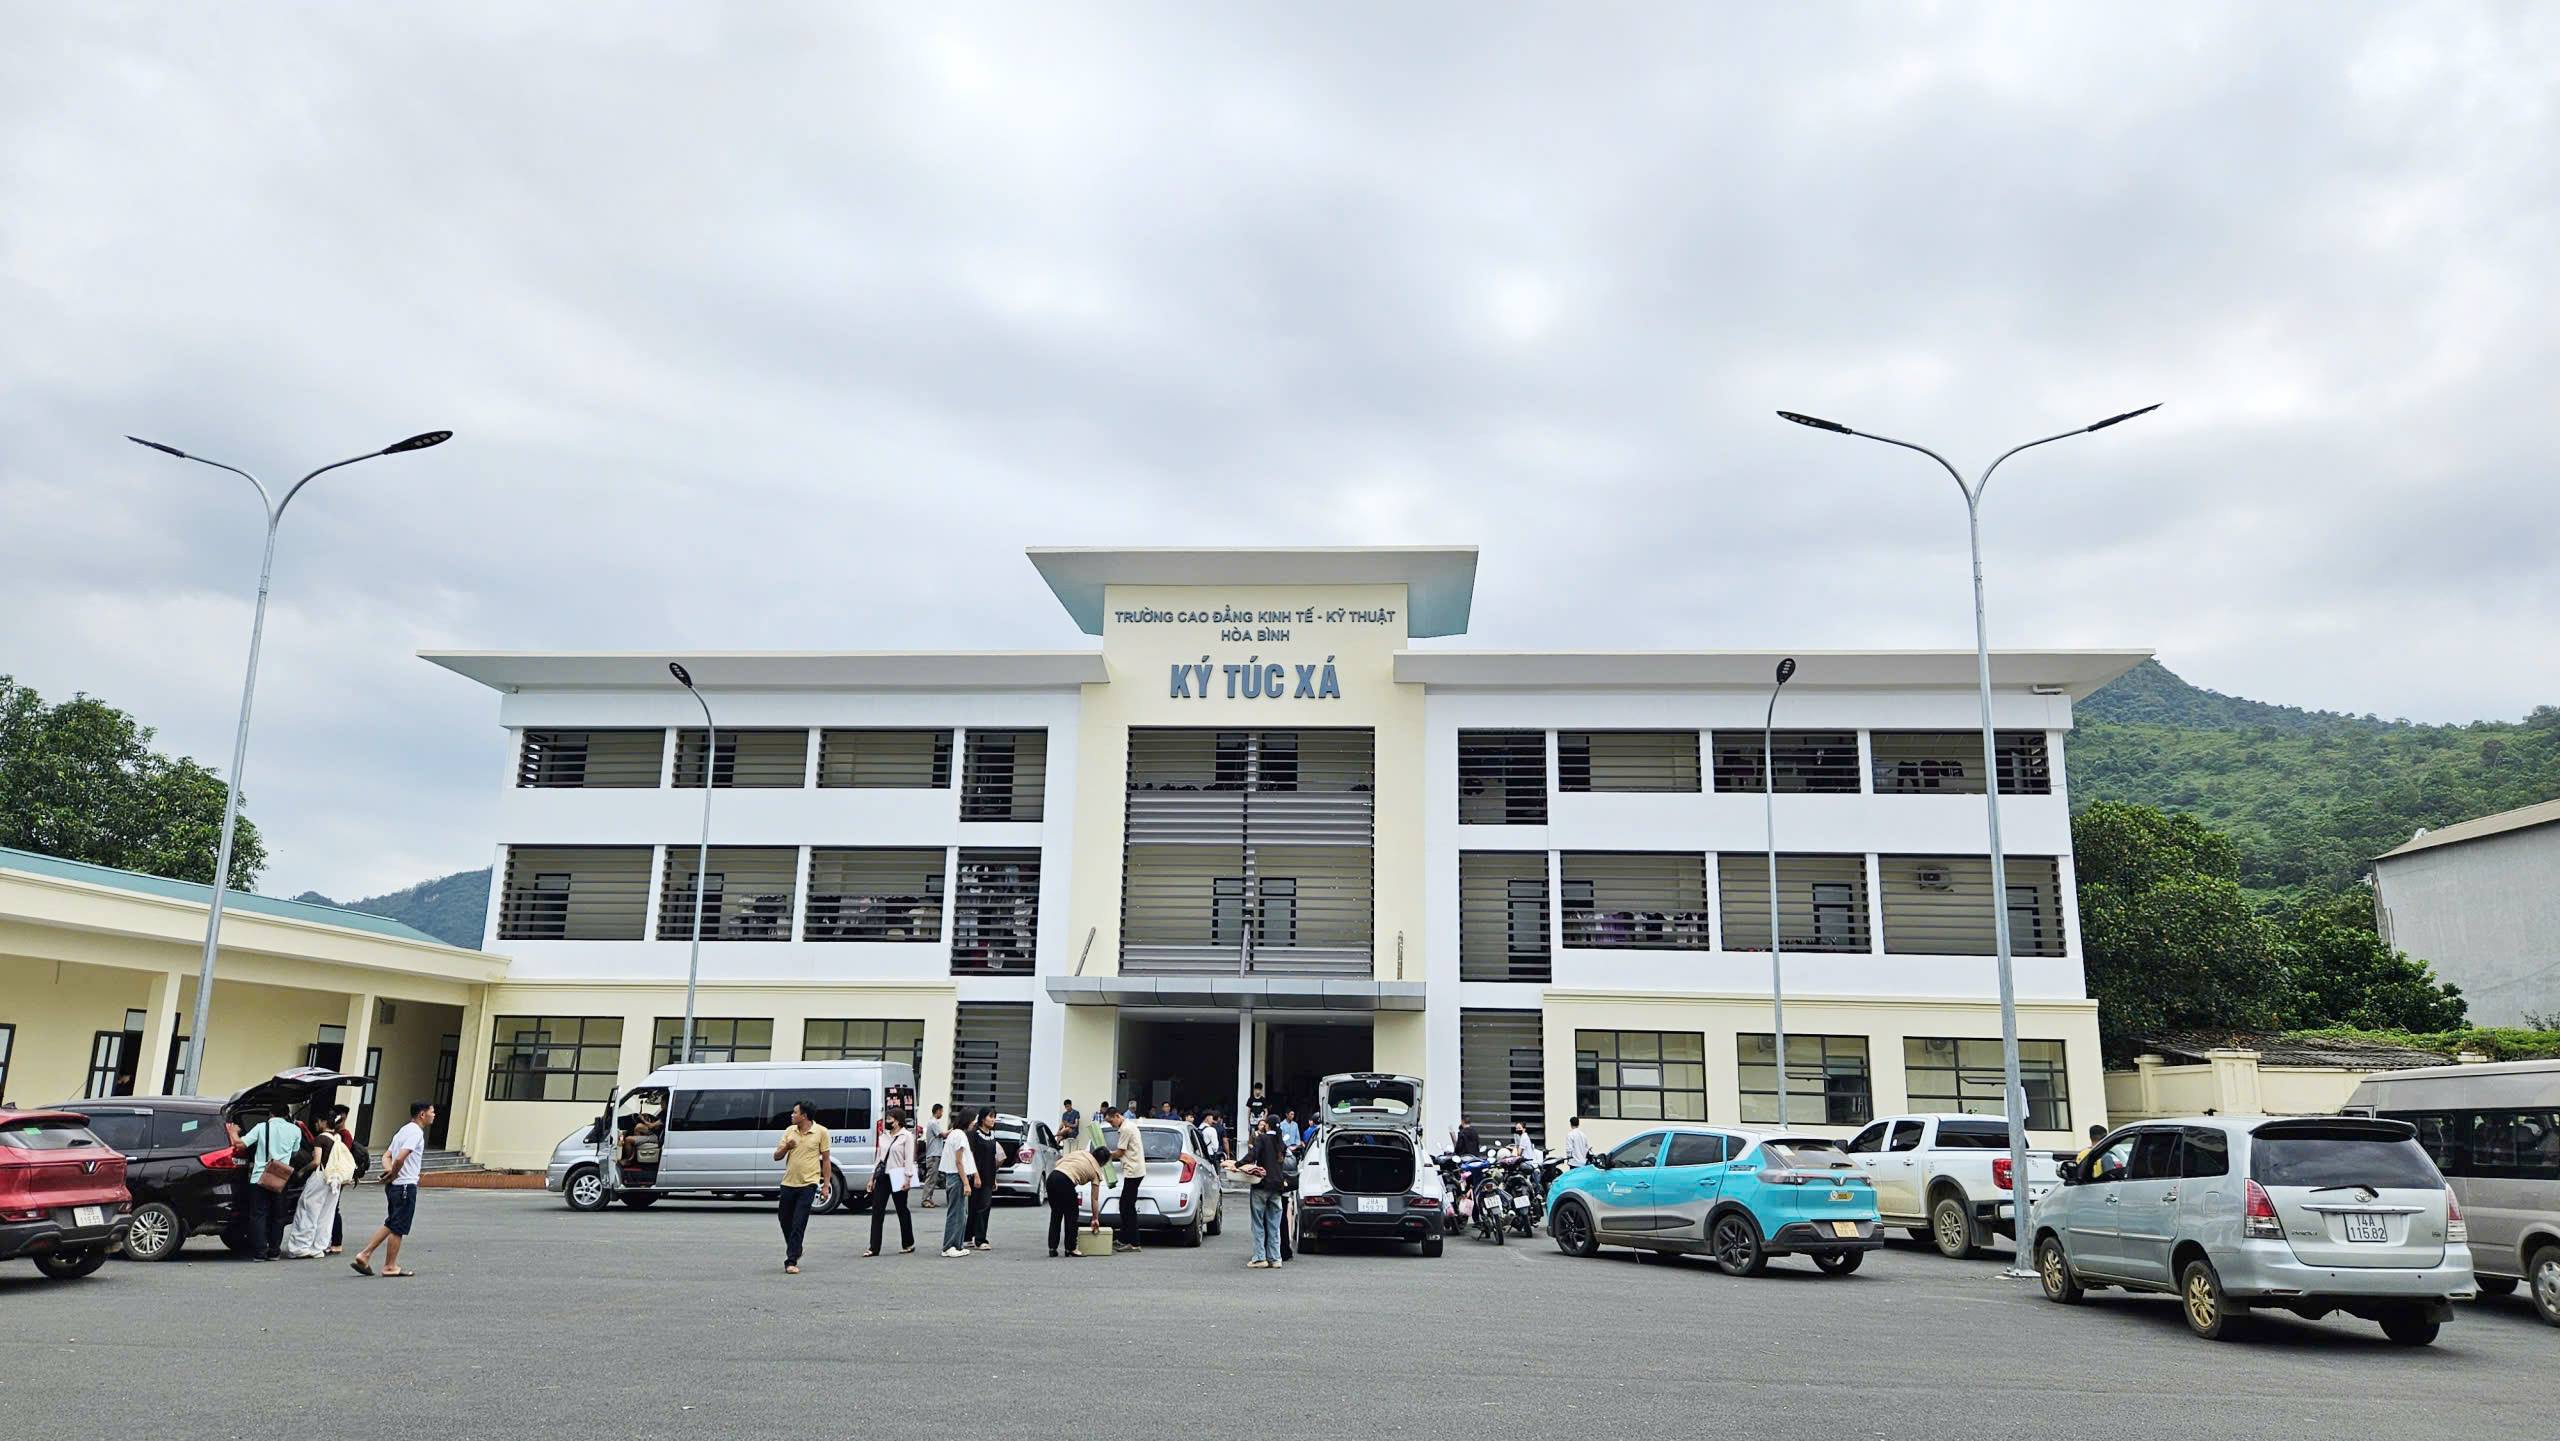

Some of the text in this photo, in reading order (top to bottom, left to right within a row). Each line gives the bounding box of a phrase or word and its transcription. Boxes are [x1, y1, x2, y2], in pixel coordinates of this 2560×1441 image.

[1115, 607, 1174, 624] TRƯỜNG
[1177, 611, 1210, 624] CAO
[1212, 604, 1254, 624] ĐẲNG
[1258, 611, 1292, 624] KINH
[1295, 606, 1315, 624] TẾ
[1326, 608, 1347, 624] KỸ
[1349, 607, 1397, 626] THUẬT
[1221, 627, 1290, 642] HÒA BÌNH
[1170, 655, 1341, 699] KÝ TÚC XÁ
[2355, 1214, 2375, 1227] 14A
[2350, 1227, 2386, 1240] 115.82
